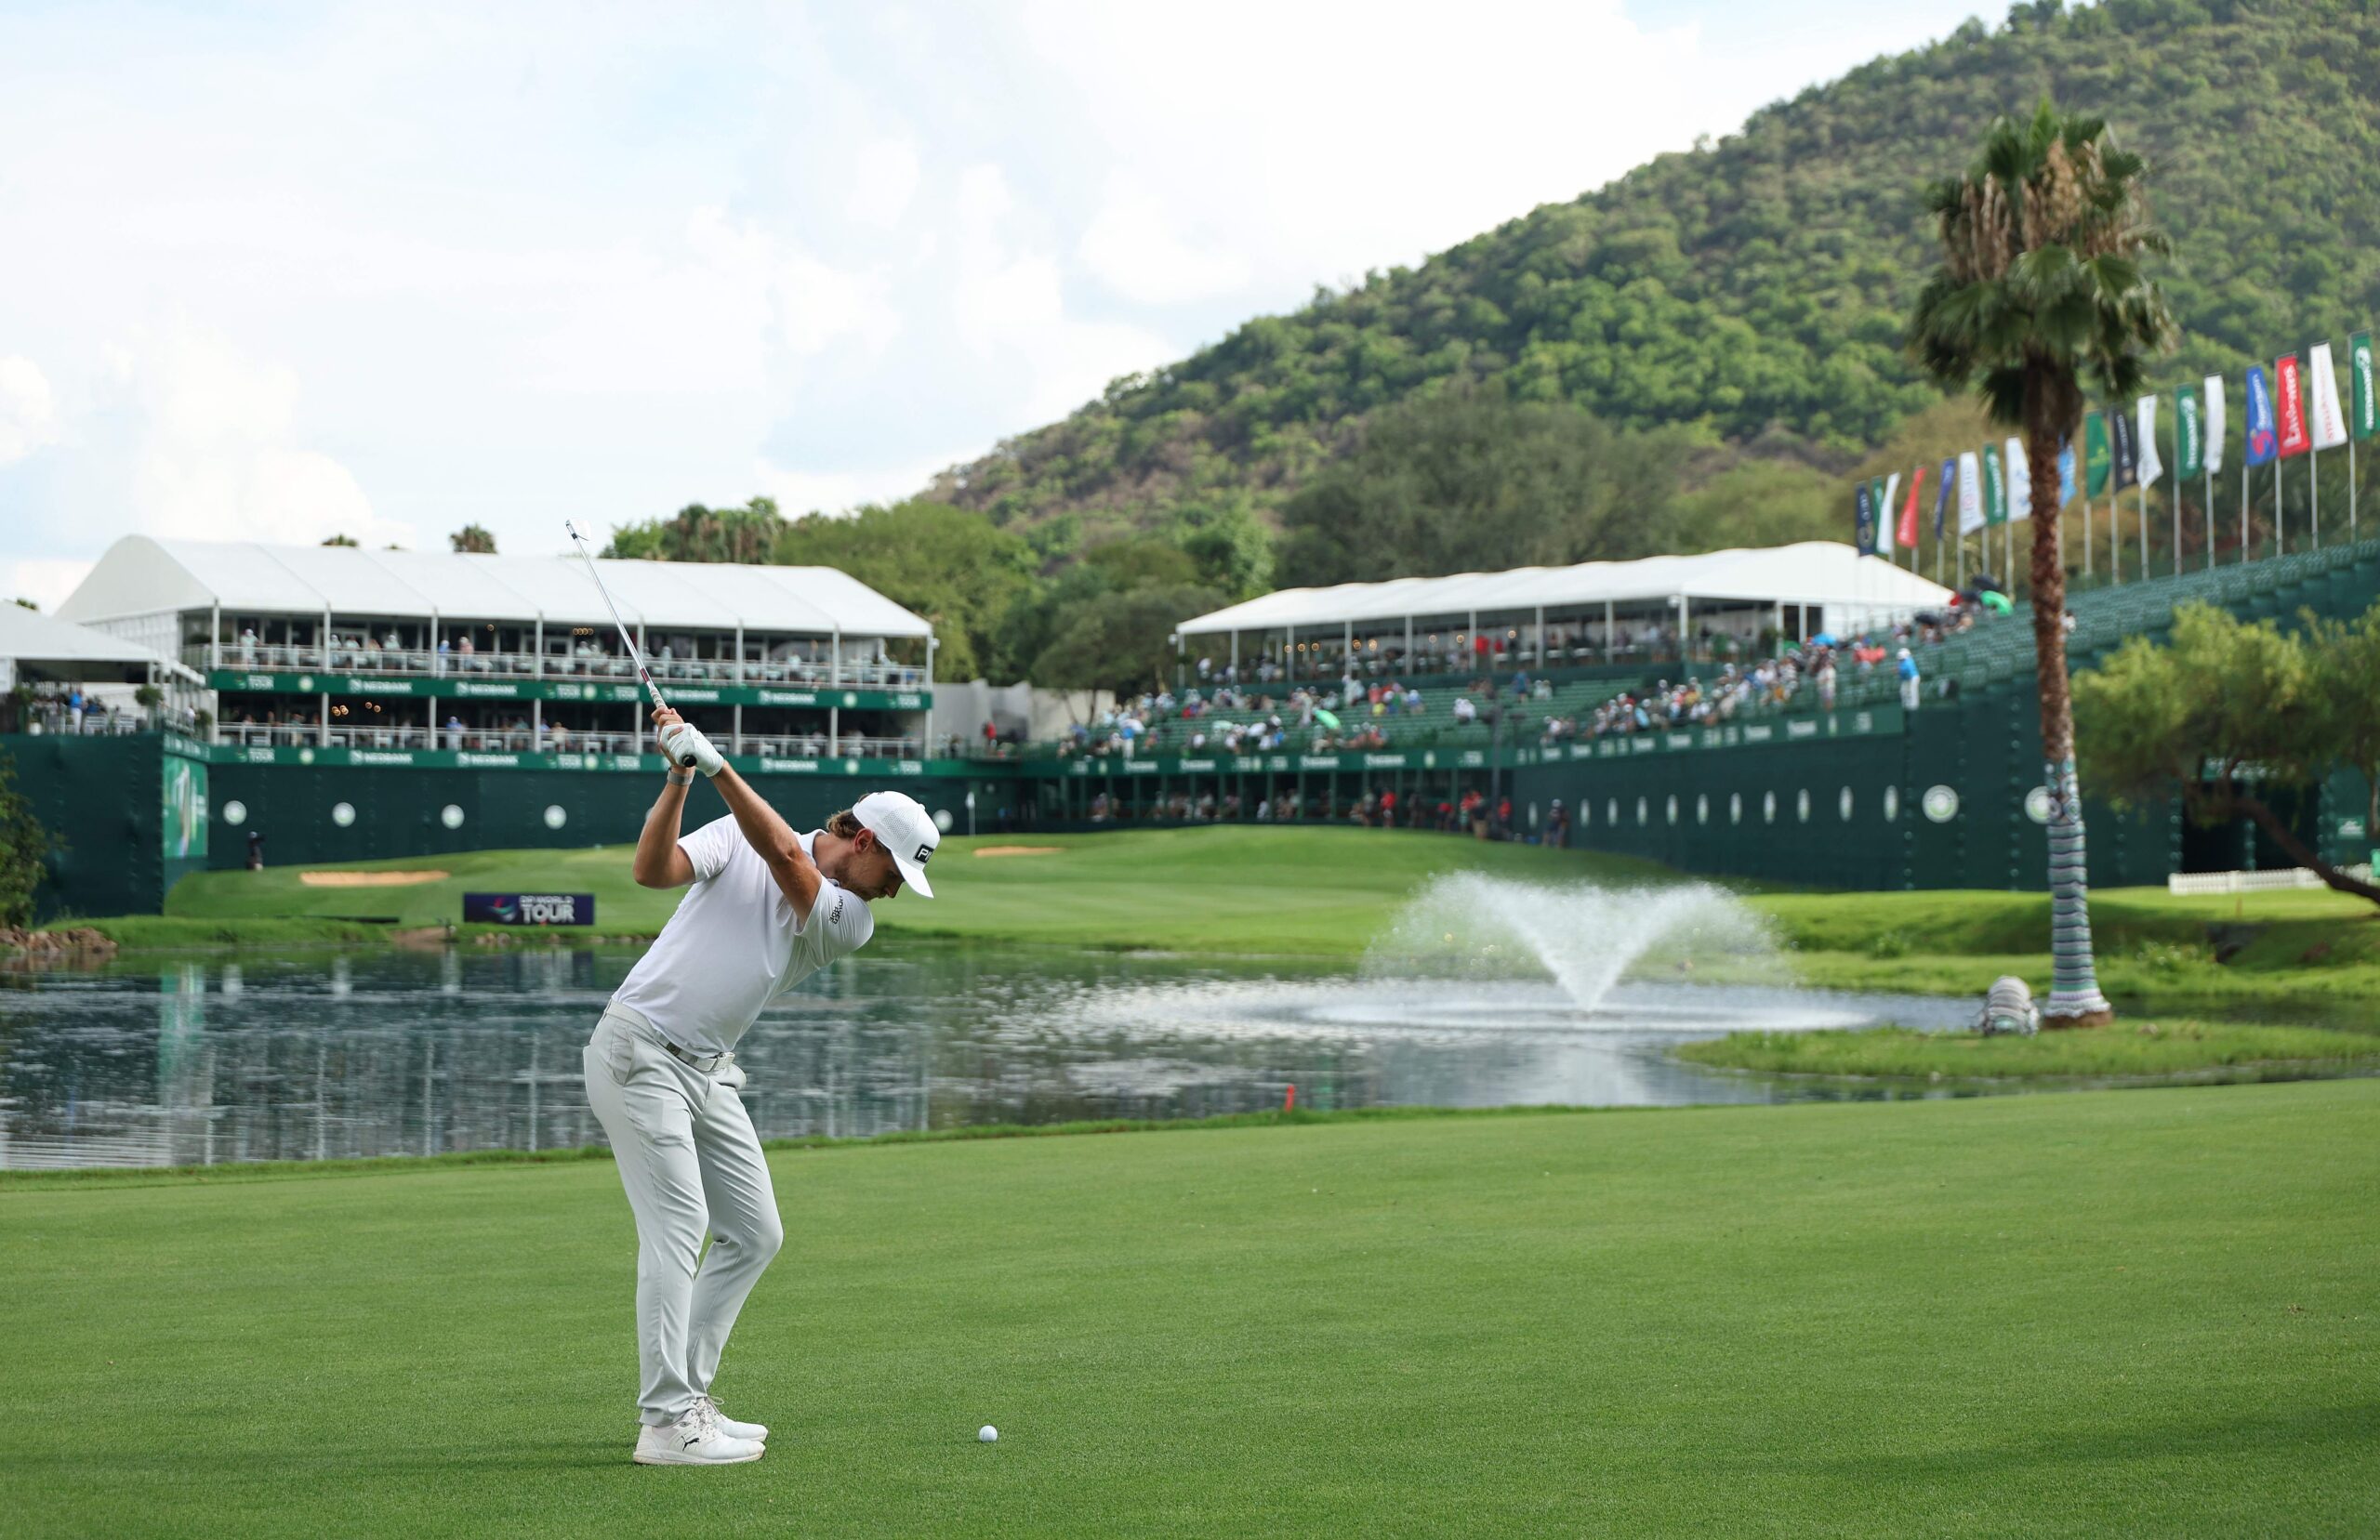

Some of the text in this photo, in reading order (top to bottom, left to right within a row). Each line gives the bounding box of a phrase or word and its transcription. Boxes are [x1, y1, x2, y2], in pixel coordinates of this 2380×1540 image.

[364, 680, 413, 693] NEDBANK
[469, 683, 518, 696] NEDBANK
[364, 752, 414, 765] NEDBANK
[470, 754, 519, 767] NEDBANK
[519, 902, 576, 925] TOUR
